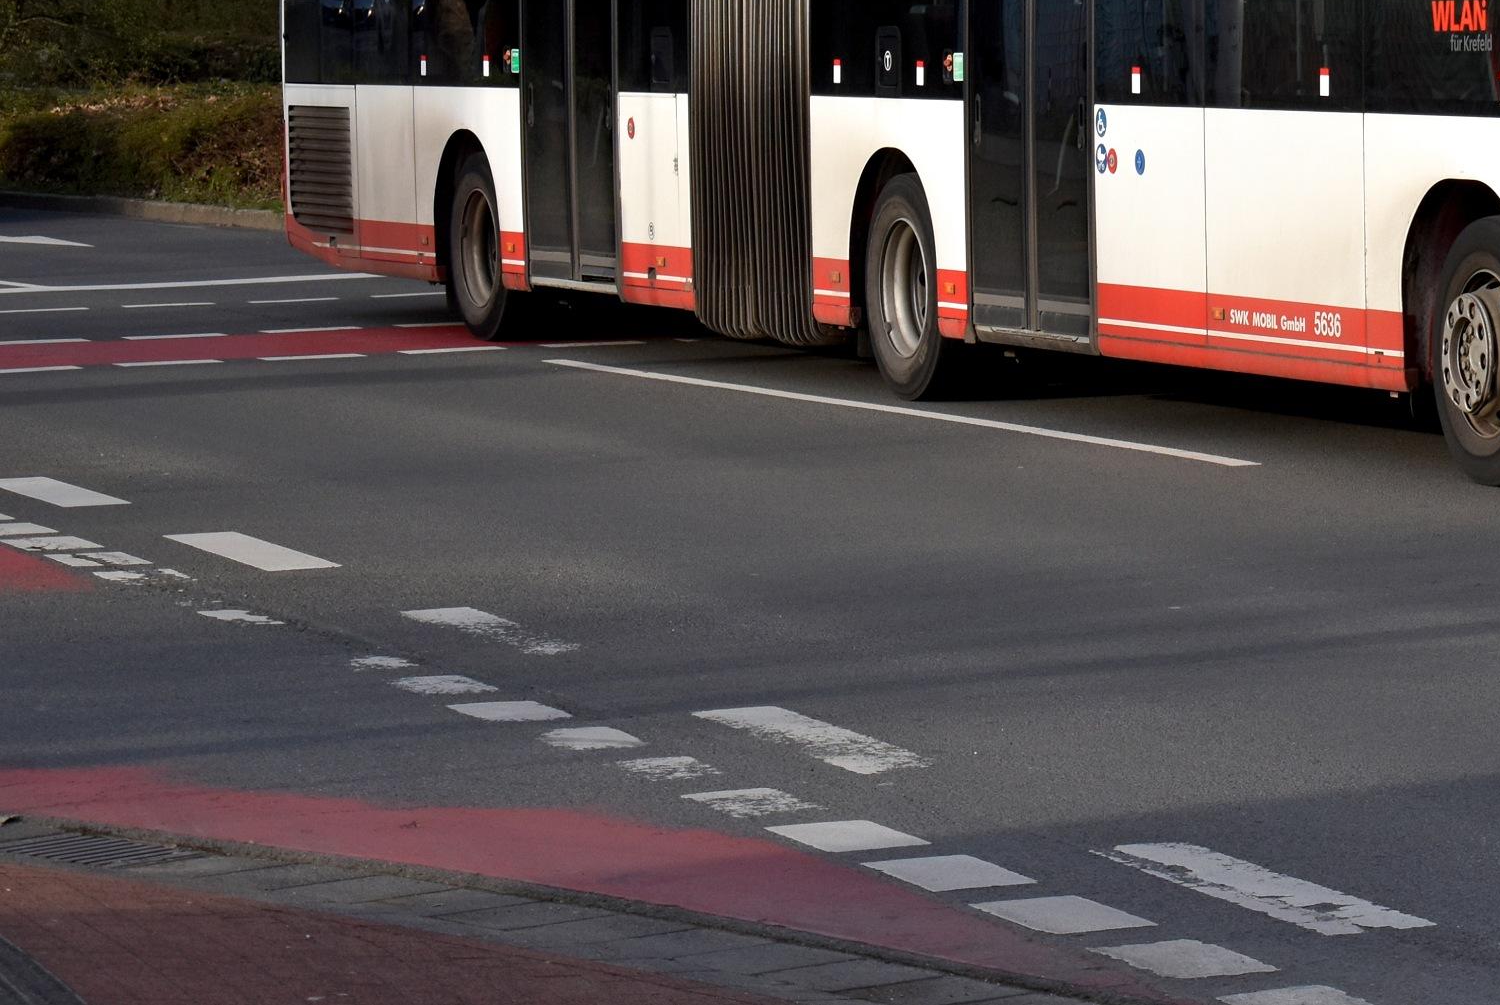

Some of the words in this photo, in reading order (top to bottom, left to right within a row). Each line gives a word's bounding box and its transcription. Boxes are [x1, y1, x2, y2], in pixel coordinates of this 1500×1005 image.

[1431, 0, 1487, 32] WLAN
[1450, 34, 1463, 52] für
[1463, 34, 1493, 52] Krefeld
[1230, 308, 1249, 326] SWK
[1252, 312, 1278, 329] MOBIL
[1280, 315, 1306, 332] GmbH
[1314, 311, 1341, 337] 5636
